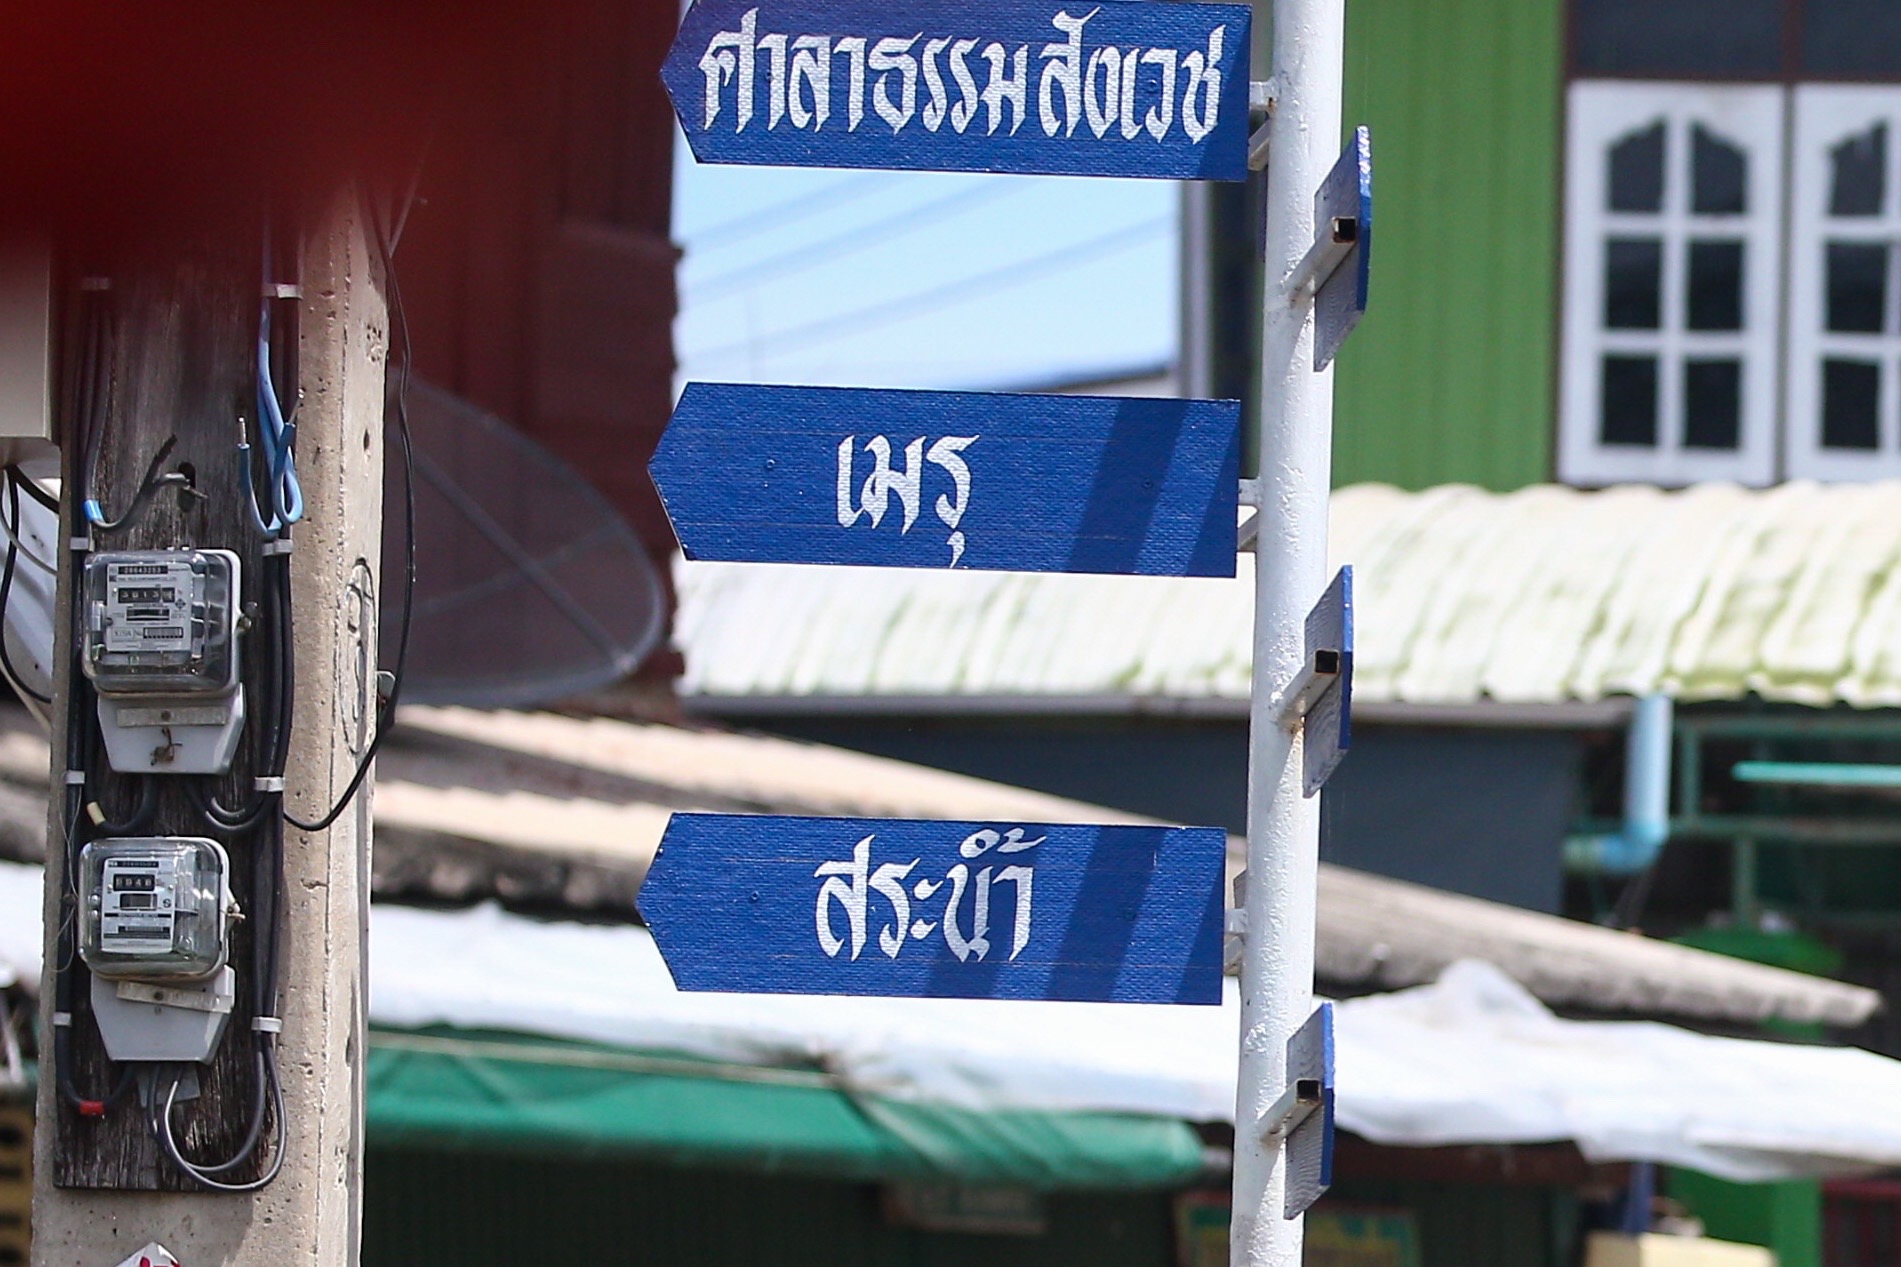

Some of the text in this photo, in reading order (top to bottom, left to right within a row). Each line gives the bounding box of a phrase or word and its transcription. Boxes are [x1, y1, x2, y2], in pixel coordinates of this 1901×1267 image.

[697, 7, 1225, 145] ศาลาธรรมสังเวช
[837, 434, 979, 569] เมรุ
[814, 828, 1046, 963] สระน้ำ
